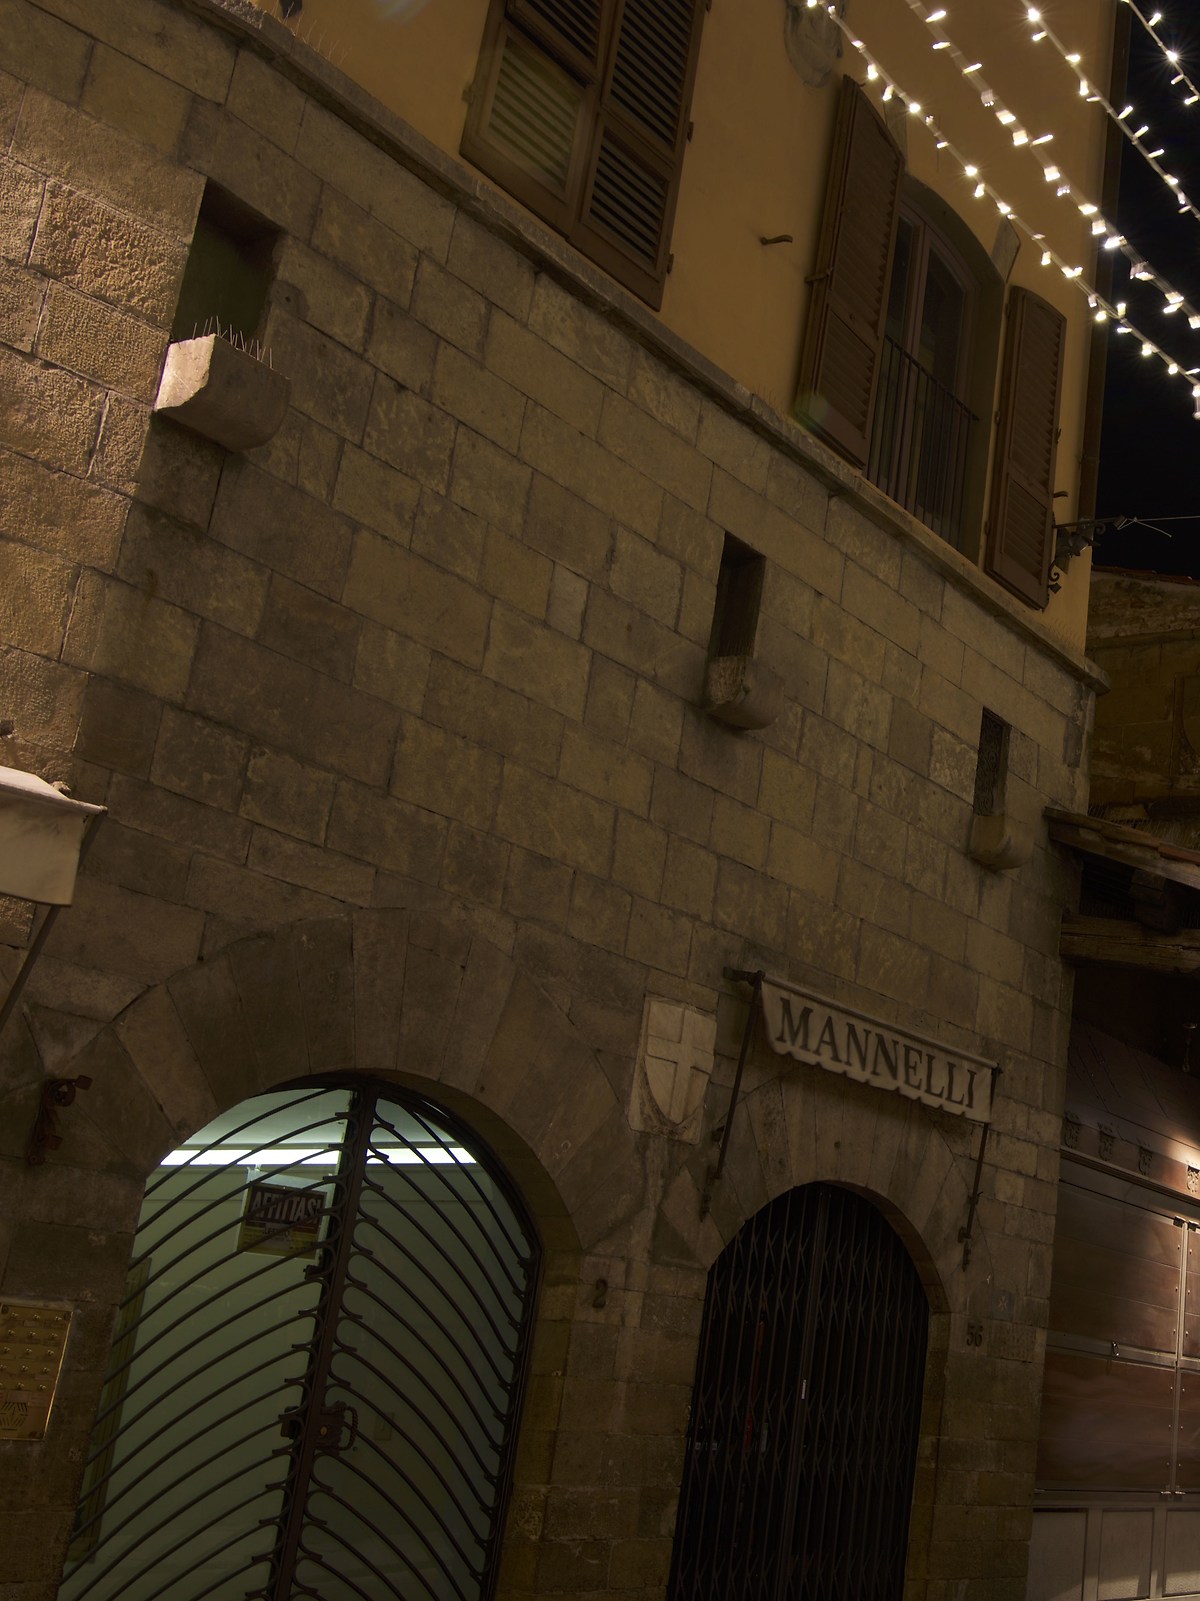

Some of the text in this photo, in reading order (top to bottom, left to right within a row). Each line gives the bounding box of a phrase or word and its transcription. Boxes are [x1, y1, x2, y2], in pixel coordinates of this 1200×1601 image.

[776, 997, 977, 1109] MANNELLI
[251, 1191, 322, 1224] AFFITTASI
[592, 1279, 607, 1308] 2
[967, 1322, 983, 1347] 56
